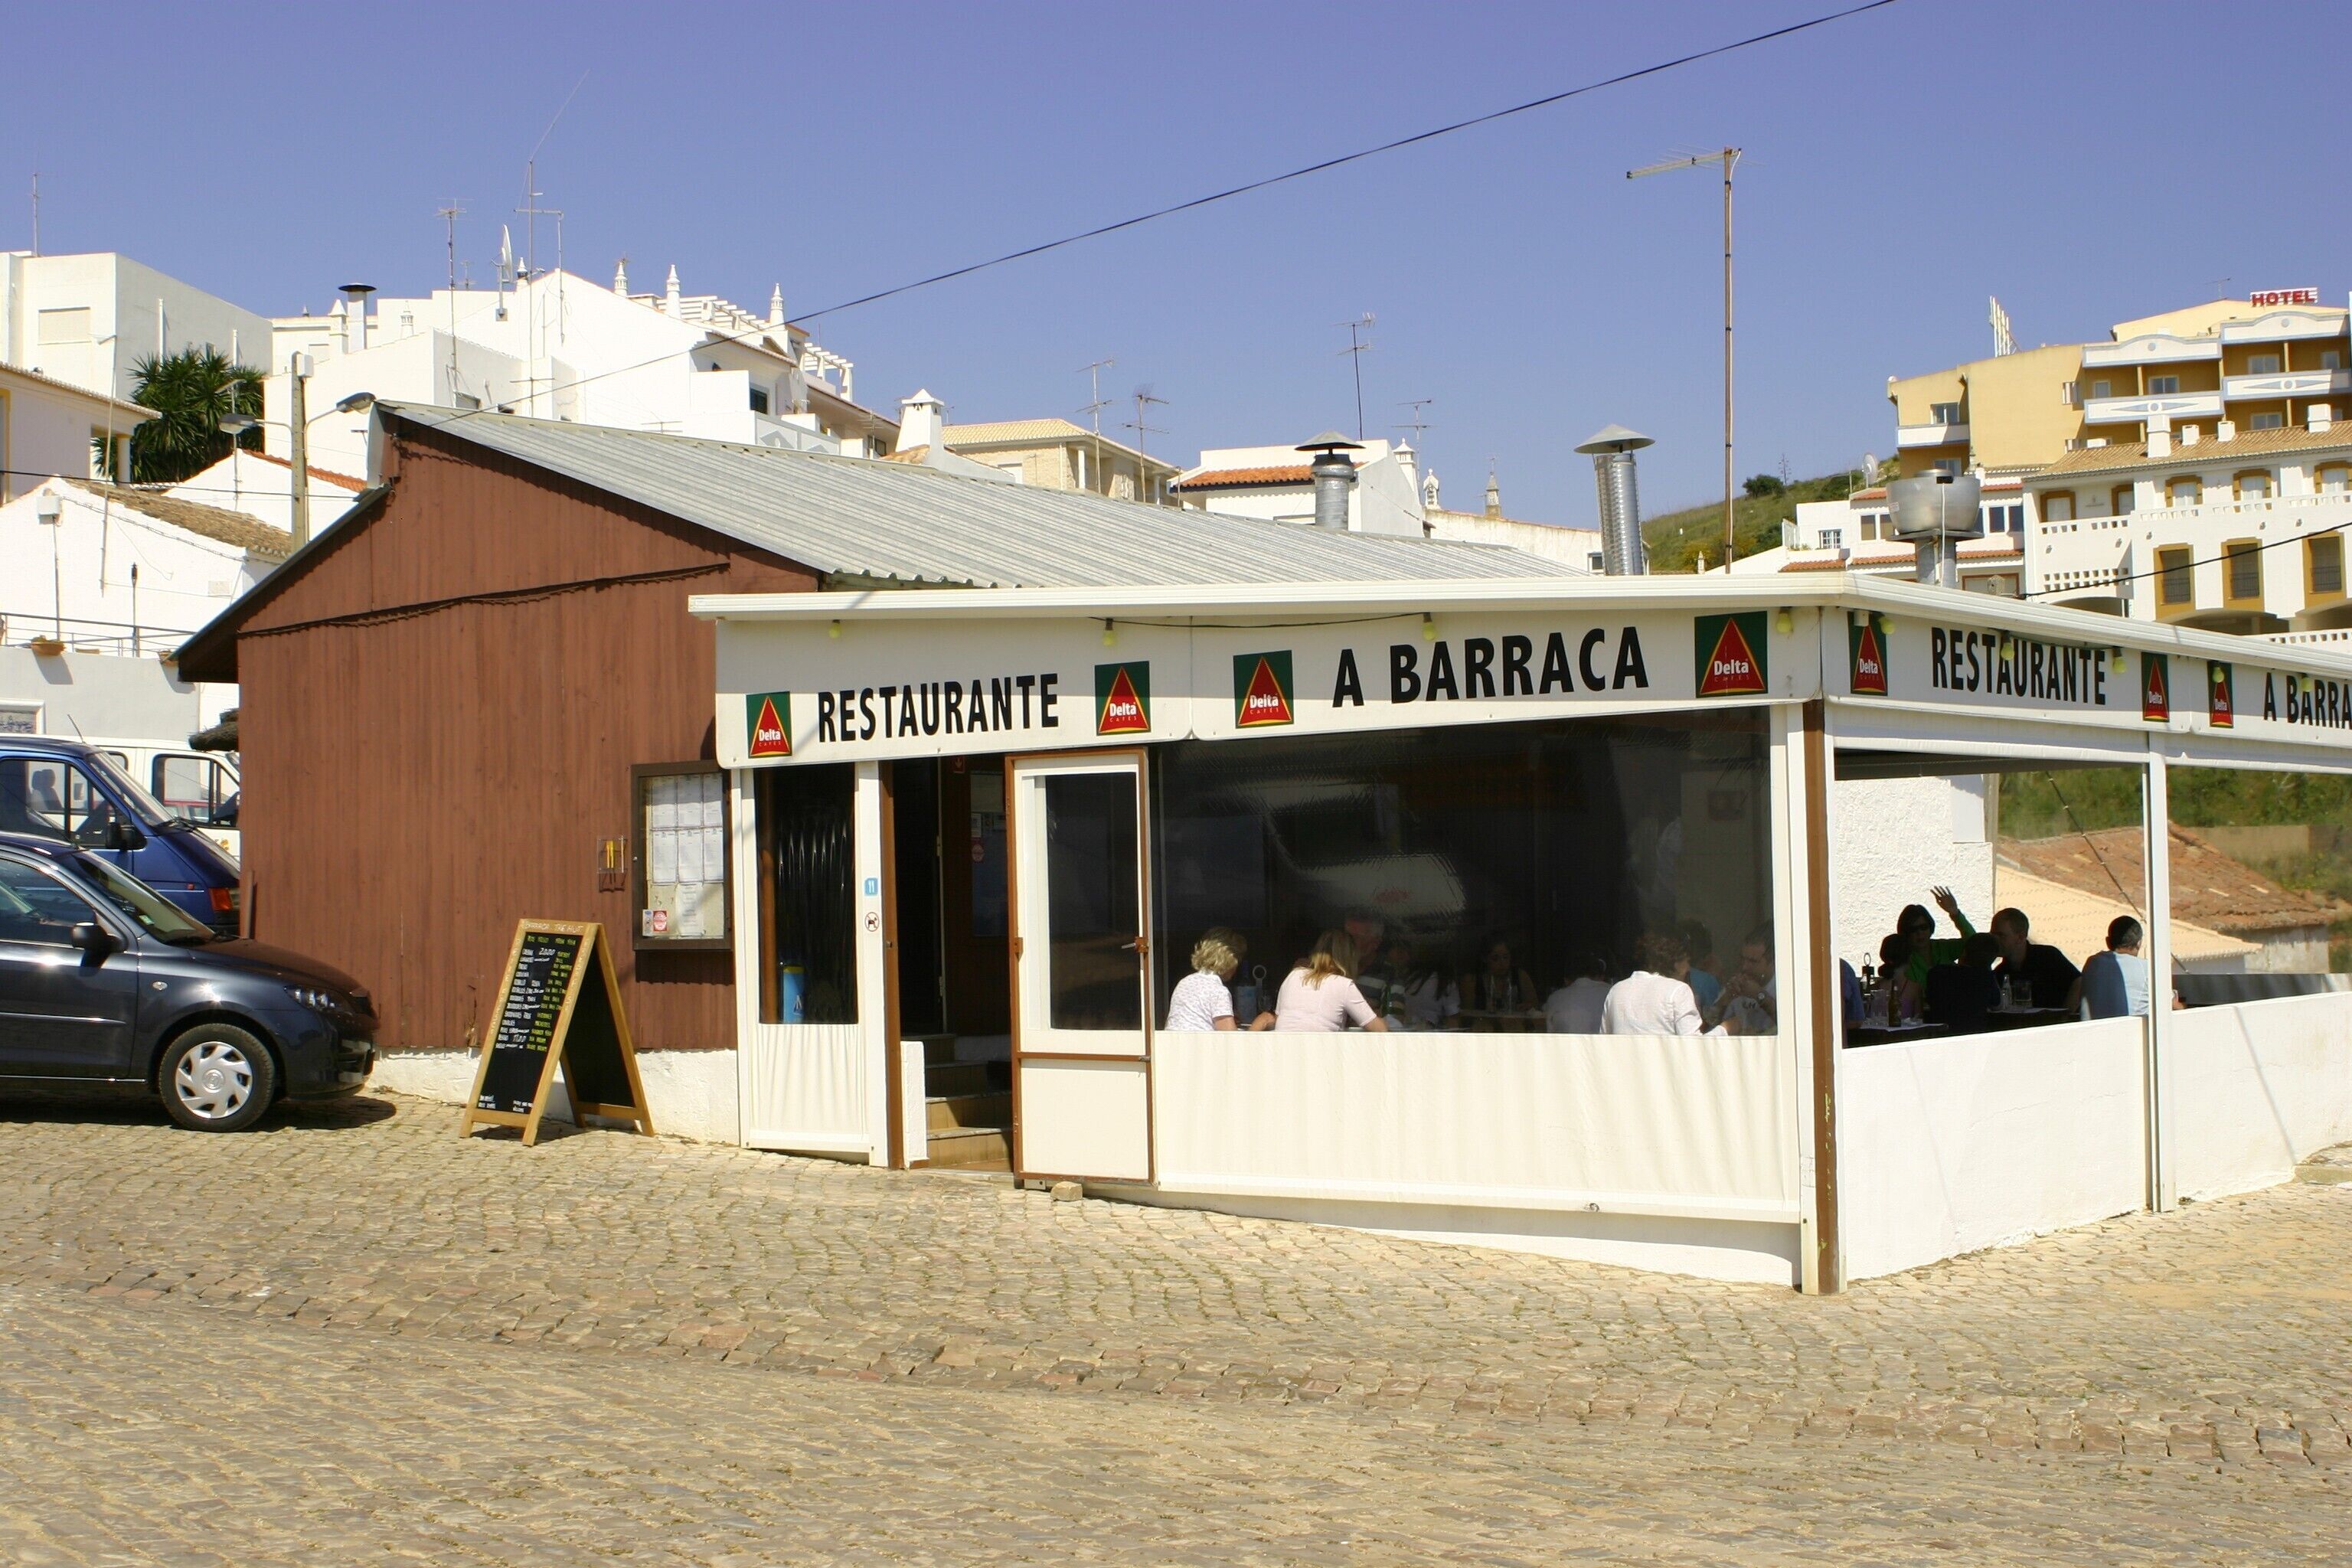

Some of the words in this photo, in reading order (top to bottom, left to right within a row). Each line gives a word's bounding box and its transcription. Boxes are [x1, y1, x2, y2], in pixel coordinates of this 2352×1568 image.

[2252, 290, 2315, 307] HOTEL
[1332, 648, 1364, 707] A
[1390, 626, 1649, 704] BARRACA
[1713, 659, 1749, 675] Delta
[1859, 658, 1879, 674] Delta
[1931, 626, 2105, 705] RESTAURANTE
[1250, 694, 1279, 708] Delta
[2263, 672, 2276, 721] A
[818, 673, 1059, 742] RESTAURANTE
[1109, 702, 1137, 717] Delta
[758, 728, 781, 741] Delta
